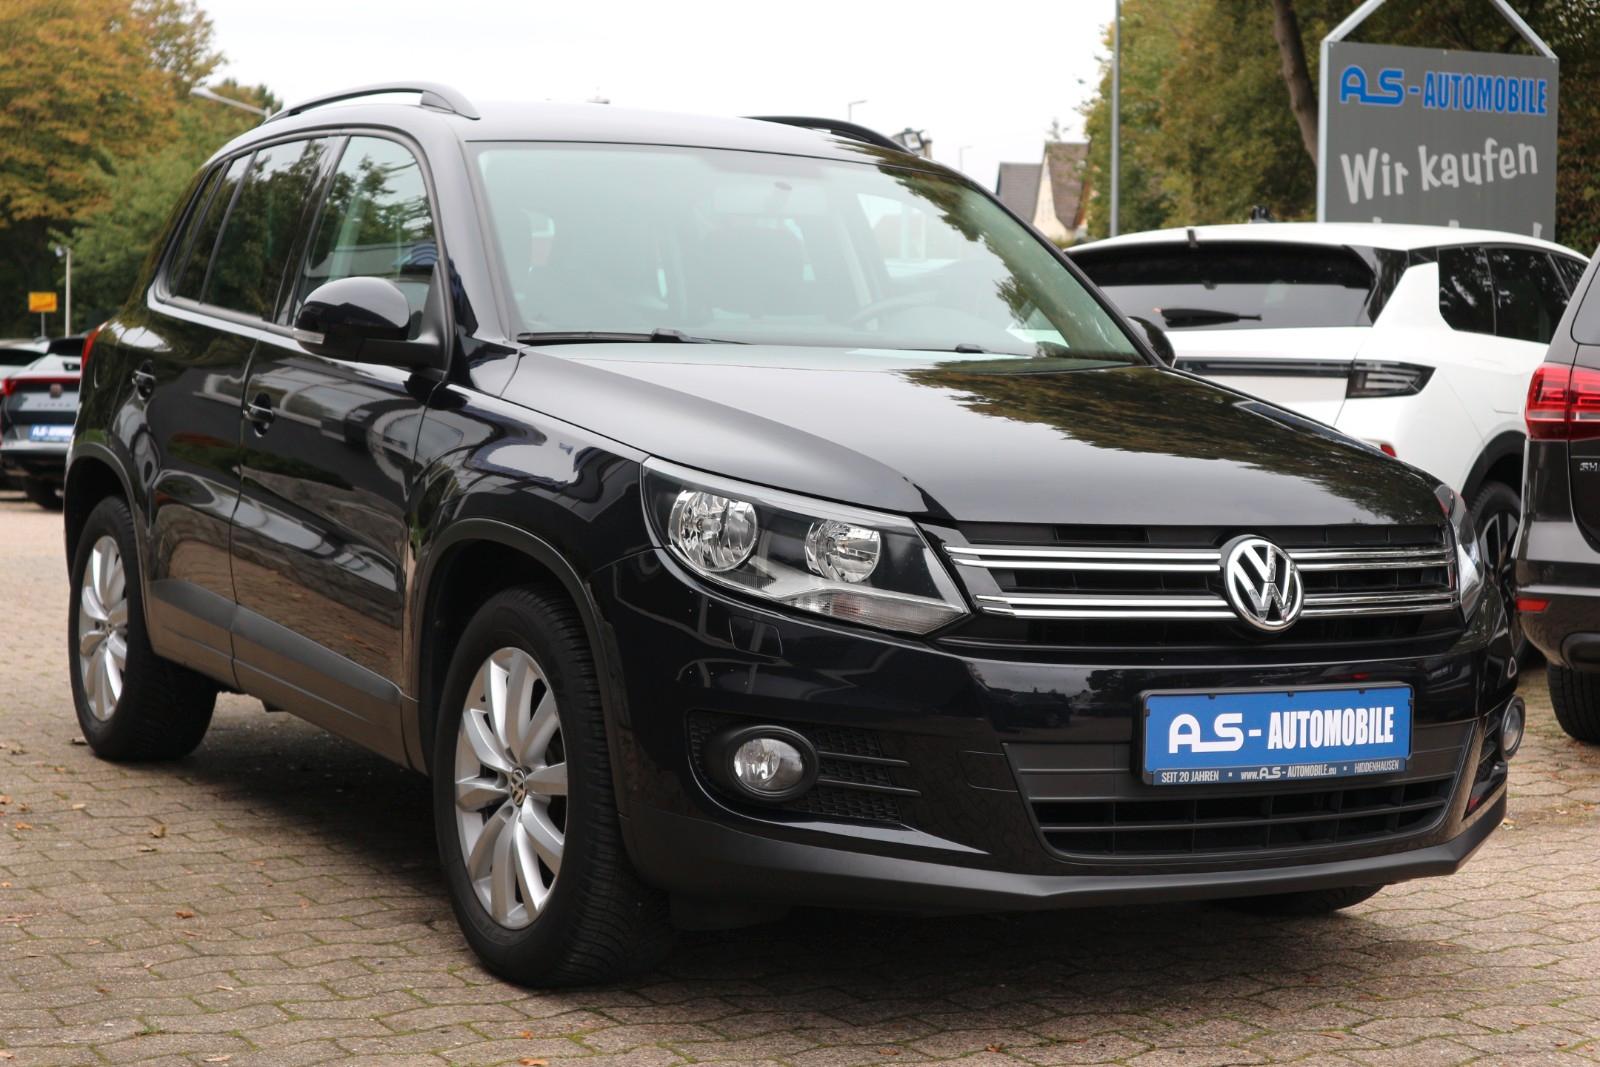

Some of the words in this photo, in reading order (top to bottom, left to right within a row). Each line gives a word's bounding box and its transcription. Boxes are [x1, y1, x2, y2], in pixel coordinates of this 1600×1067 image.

[1339, 65, 1547, 116] AS-AUTOMOBILE
[1340, 147, 1409, 204] Wir
[1417, 137, 1538, 191] kaufen
[1168, 706, 1394, 754] AS-AUTOMOBILE
[1161, 772, 1178, 783] SEIT
[1179, 771, 1190, 782] 20
[1190, 770, 1219, 782] JAHREN
[1354, 760, 1399, 774] HIDDENHAUSEN
